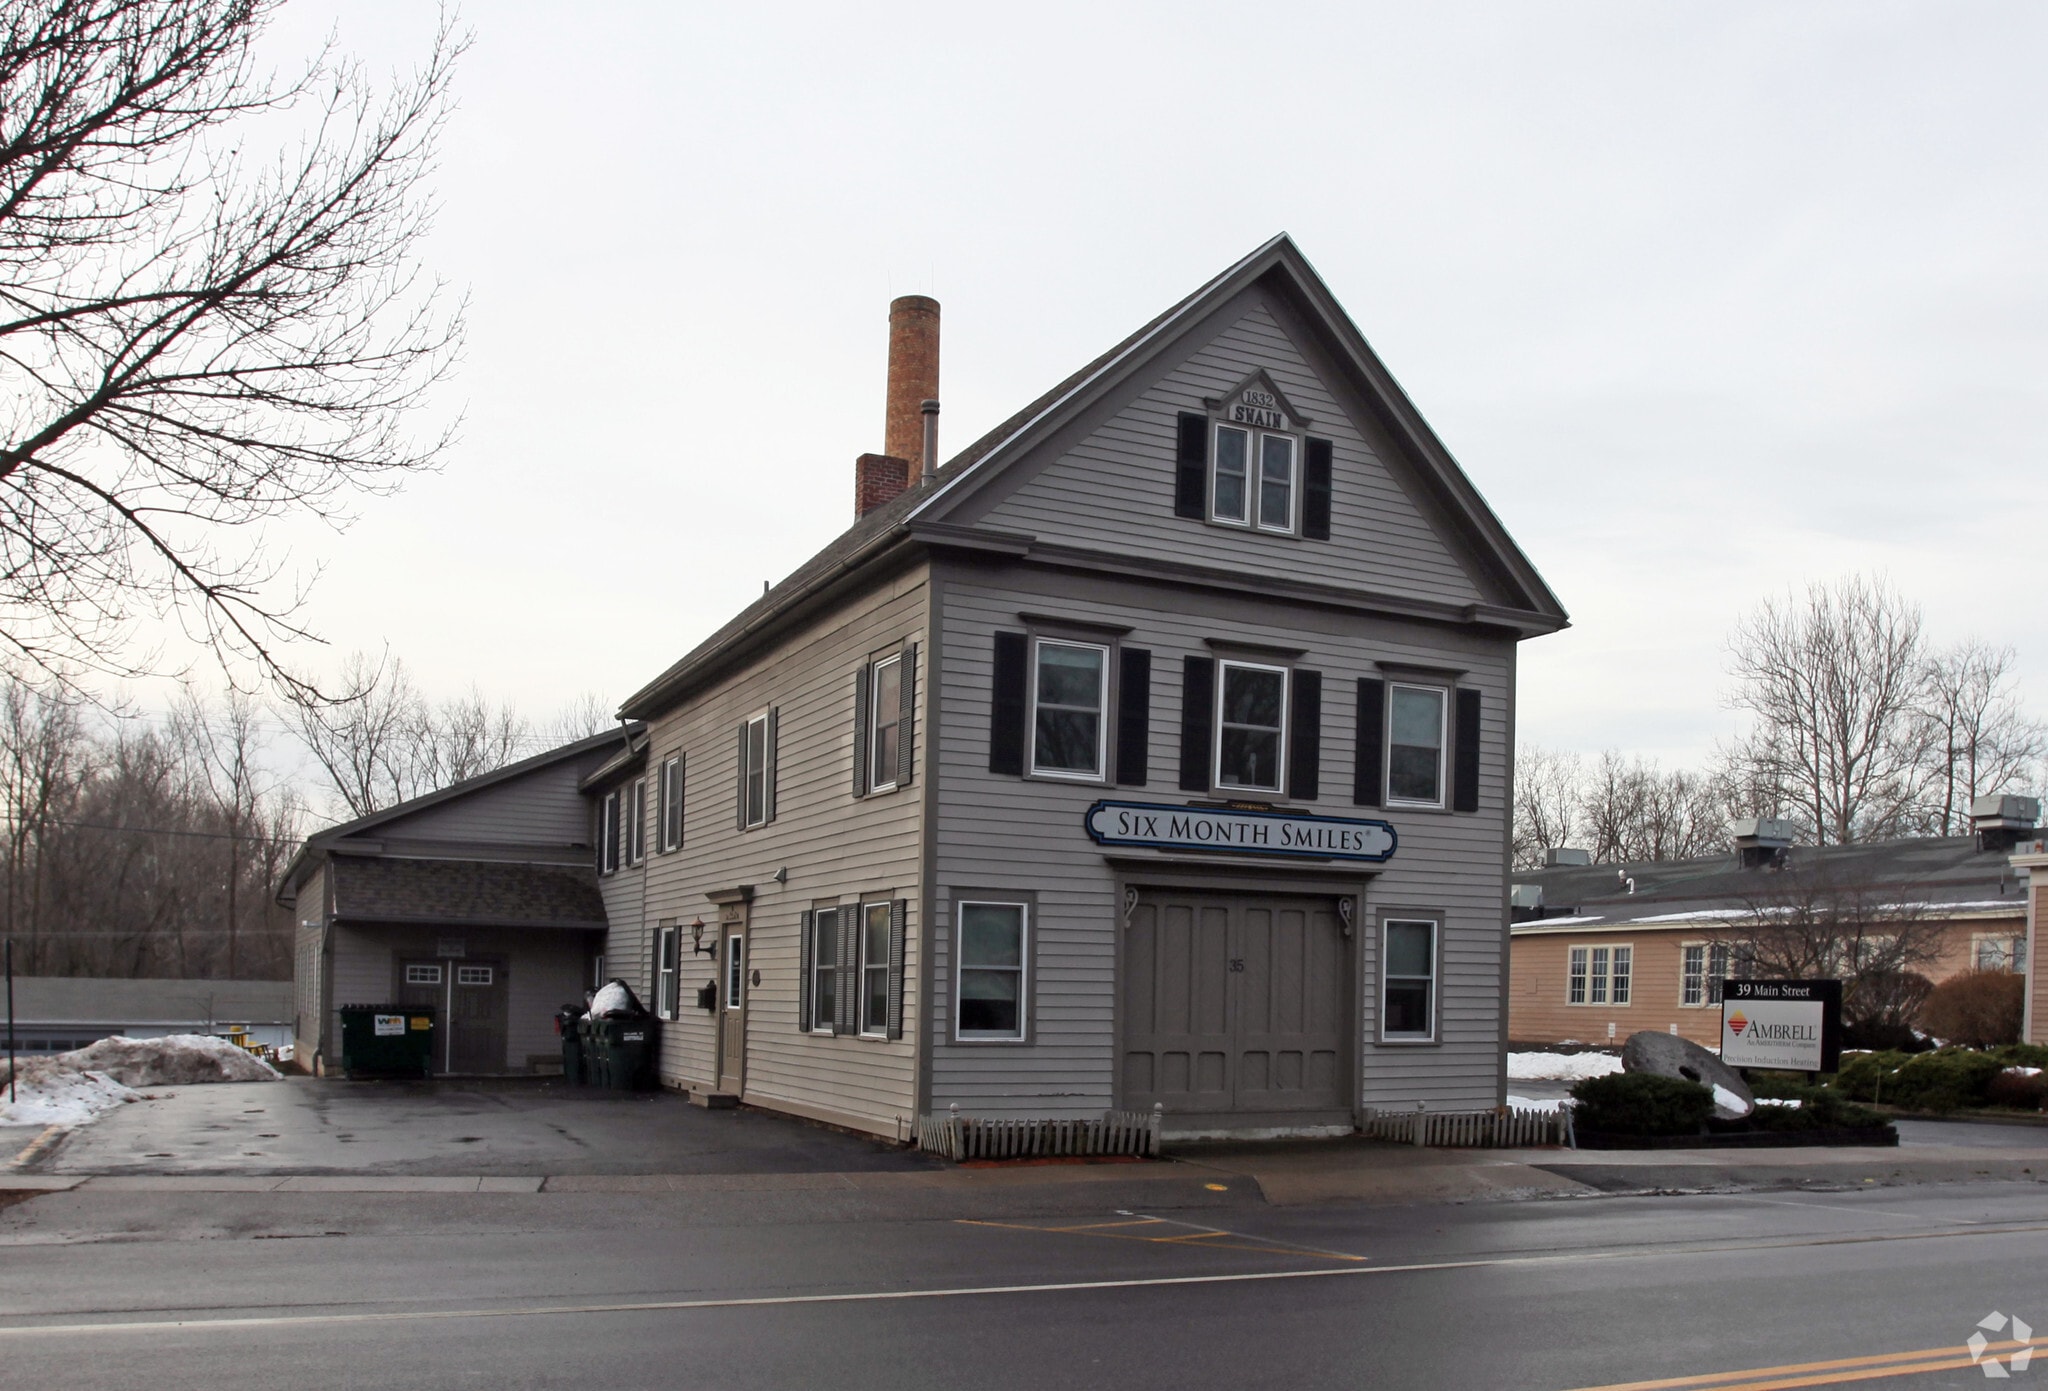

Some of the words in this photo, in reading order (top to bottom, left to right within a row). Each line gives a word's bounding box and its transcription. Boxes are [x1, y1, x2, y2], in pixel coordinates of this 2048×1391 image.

[1246, 391, 1274, 407] 1832
[1235, 406, 1282, 428] SWAIN
[1117, 811, 1159, 838] SIX
[1169, 815, 1269, 845] MONTH
[1229, 959, 1244, 973] 35
[1736, 984, 1751, 996] 39
[1754, 985, 1779, 997] Main
[1782, 984, 1811, 997] Street
[1746, 1020, 1817, 1041] AMBRELL
[1724, 1054, 1753, 1064] Precision
[1754, 1056, 1789, 1065] Induction
[1790, 1057, 1820, 1068] Heating
